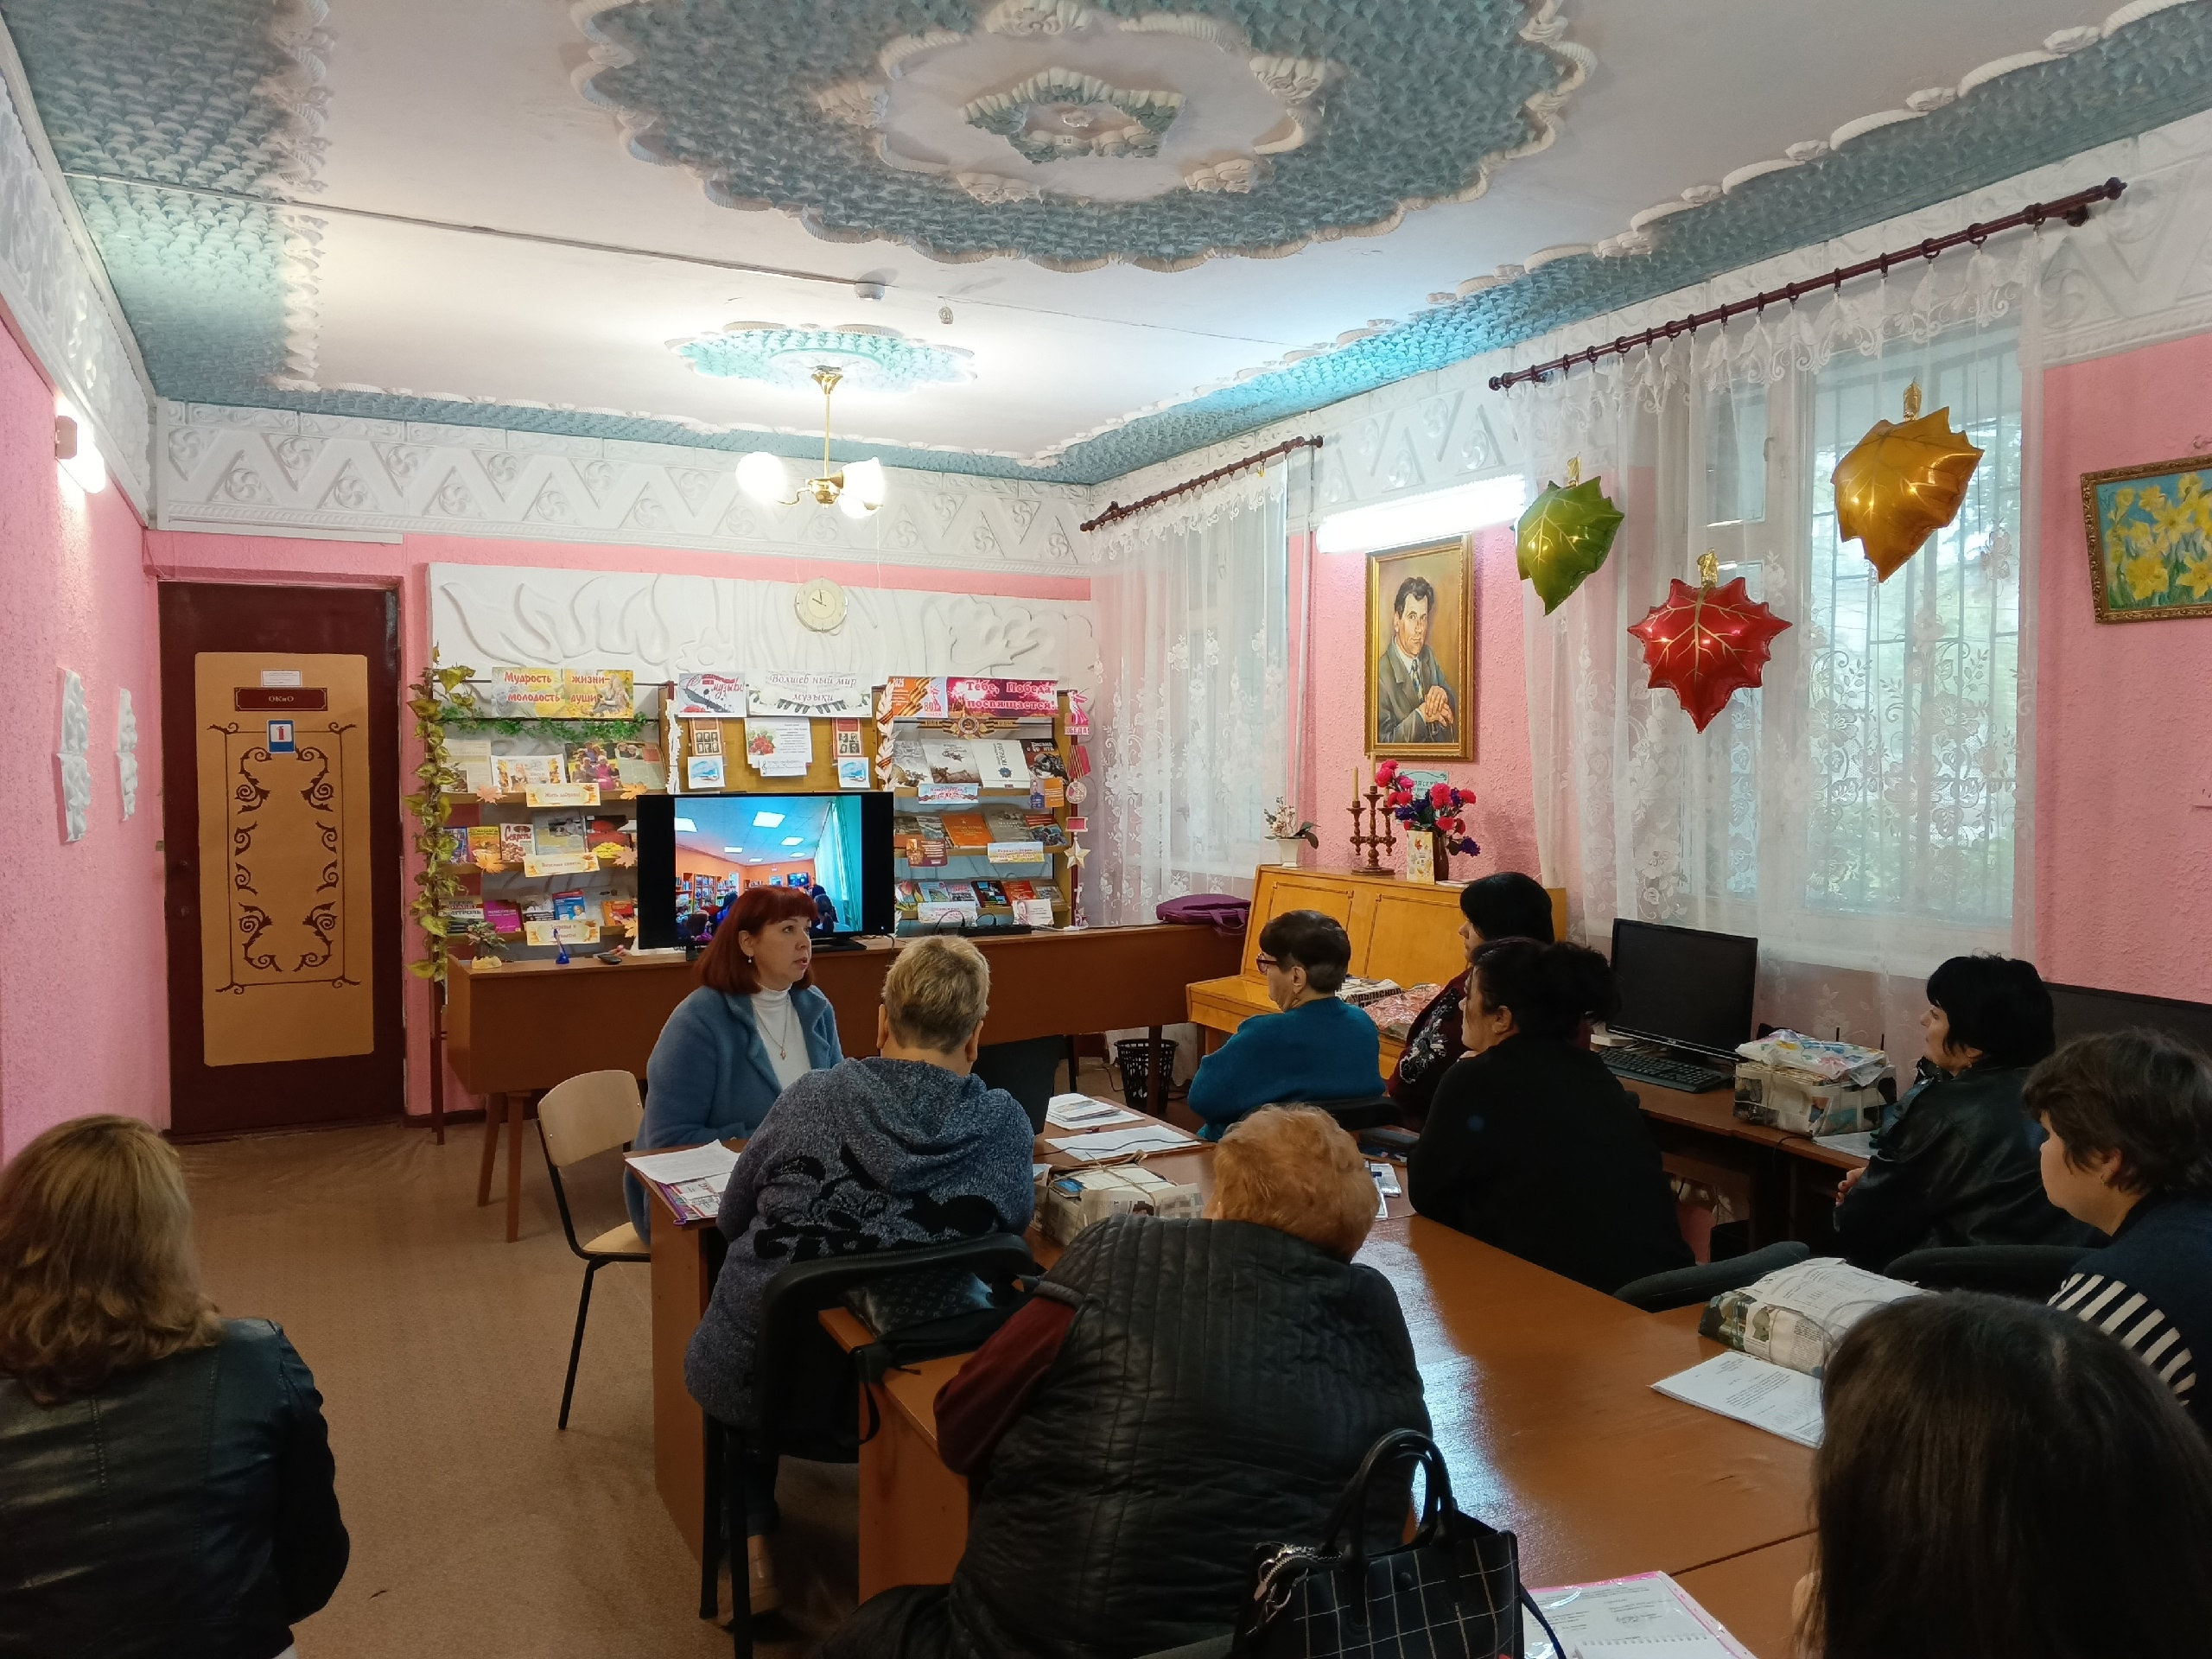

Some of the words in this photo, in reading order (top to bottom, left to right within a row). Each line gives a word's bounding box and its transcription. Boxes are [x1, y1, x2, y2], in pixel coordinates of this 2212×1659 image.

[505, 671, 552, 685] Мудрость
[836, 677, 856, 688] мир
[966, 681, 1000, 694] Тебе,
[1007, 682, 1054, 695] Победа,
[508, 693, 560, 702] молодость
[570, 694, 597, 702] души
[792, 693, 833, 703] музыки
[967, 699, 1054, 709] посвящается!
[505, 825, 531, 842] Секреты
